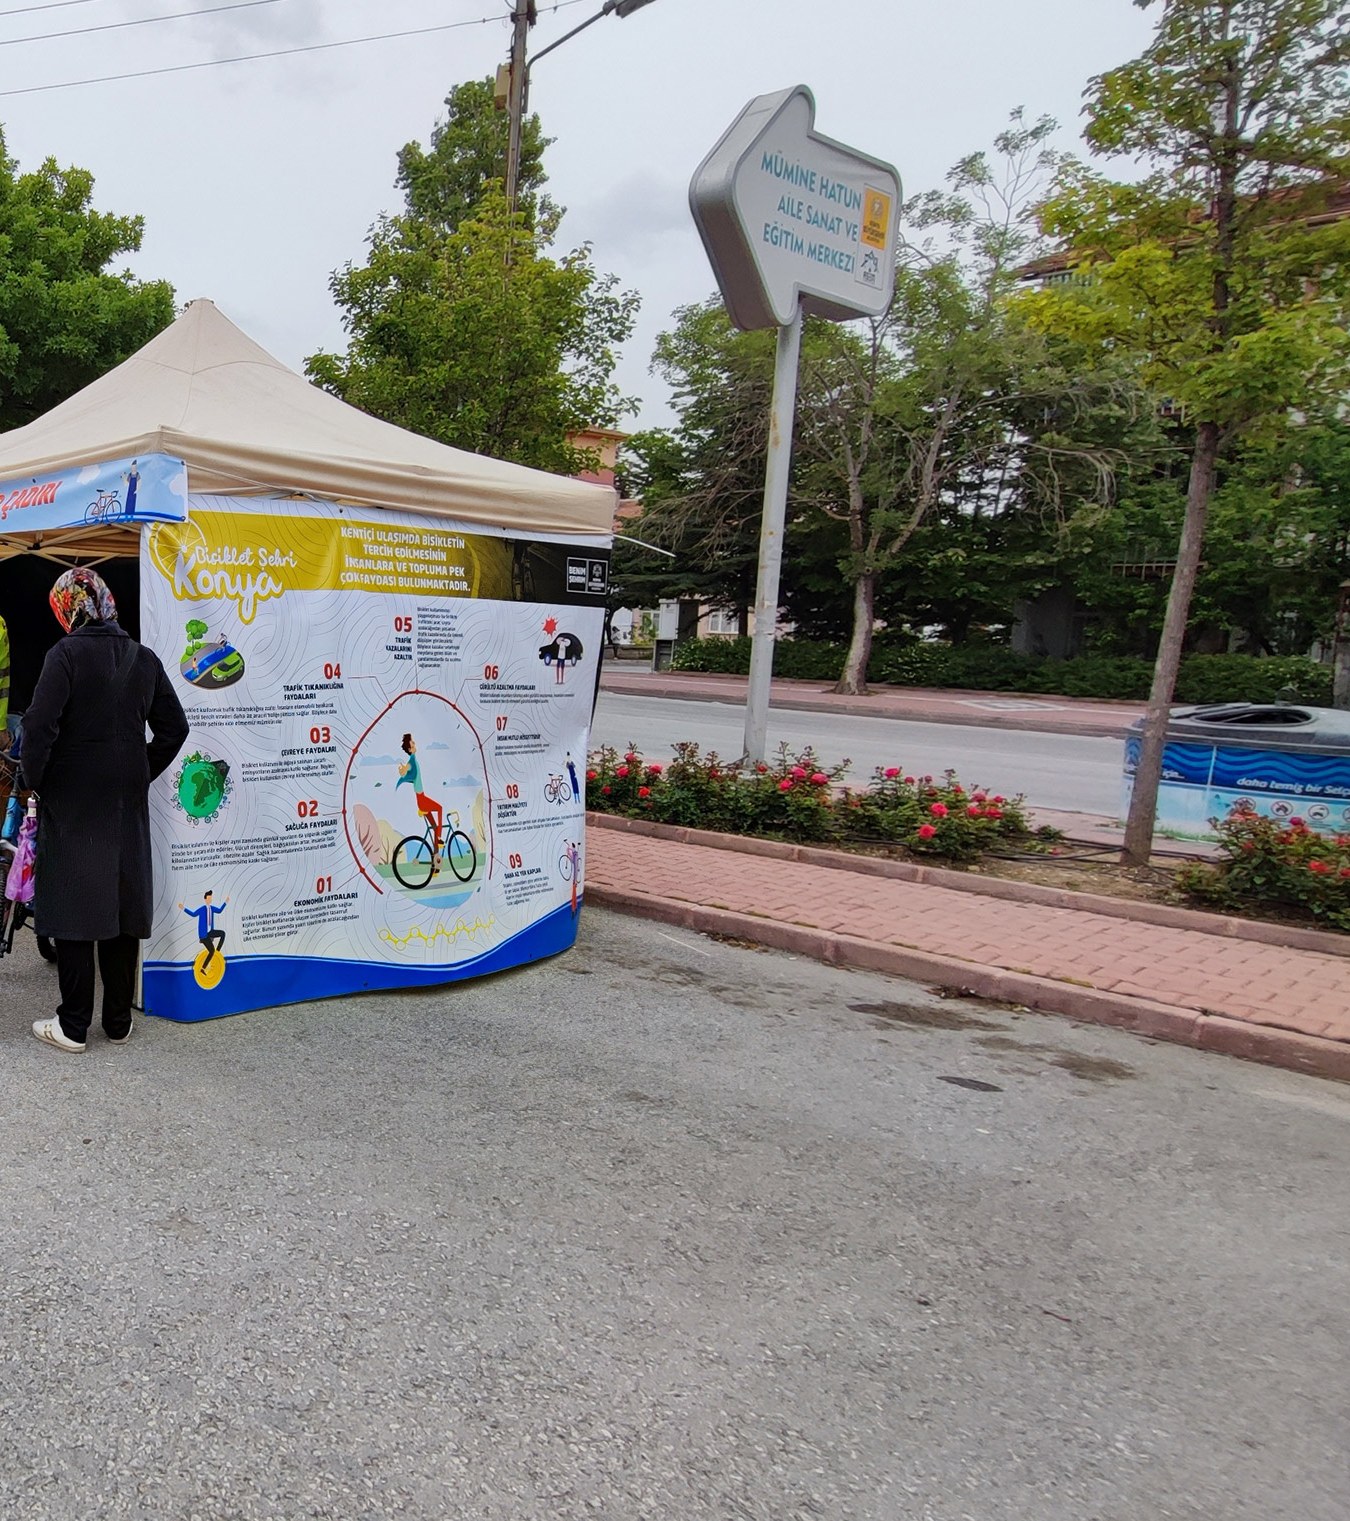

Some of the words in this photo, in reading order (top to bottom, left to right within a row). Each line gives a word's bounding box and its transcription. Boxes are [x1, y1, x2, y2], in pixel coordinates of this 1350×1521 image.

[761, 150, 816, 192] MÜMİNE
[819, 176, 862, 212] HATUN
[777, 191, 804, 220] AİLE
[806, 204, 842, 236] SANAT
[845, 220, 858, 242] VE
[763, 221, 804, 256] EĞİTİM
[807, 240, 855, 274] MERKEZİ
[2, 480, 62, 520] ÇADIRI
[341, 527, 374, 542] KENTİÇİ
[377, 531, 420, 545] ULAŞIMDA
[422, 534, 465, 549] BİSİKLETİN
[258, 547, 297, 570] Şehri
[363, 543, 393, 557] TERCİH
[395, 547, 446, 562] EDİLMESİNİN
[345, 555, 395, 572] İNSANLARA
[396, 562, 407, 572] VE
[409, 563, 447, 576] TOPLUMA
[450, 567, 465, 577] PEK
[174, 552, 282, 620] Konya
[398, 577, 470, 592] BULUNMAKTADIR.
[394, 616, 412, 632] 05
[324, 662, 341, 679] 04
[484, 665, 498, 680] 06
[283, 682, 303, 691] TRAFİK
[304, 682, 344, 691] TIKANIKLIĞINA
[496, 716, 508, 731] 07
[310, 726, 331, 744] 03
[281, 748, 304, 757] ÇEVREYE
[306, 746, 336, 754] FAYDALARI
[506, 783, 519, 799] 08
[1236, 778, 1268, 788] daha
[1269, 780, 1303, 793] temiz
[1306, 783, 1324, 793] bir
[298, 800, 318, 818] 02
[285, 821, 308, 832] SAĞLIĞA
[309, 819, 338, 828] FAYDALARI
[509, 853, 522, 869] 09
[316, 876, 332, 894] 01
[294, 896, 323, 907] EKONOMİK
[324, 892, 358, 902] FAYDALARI
